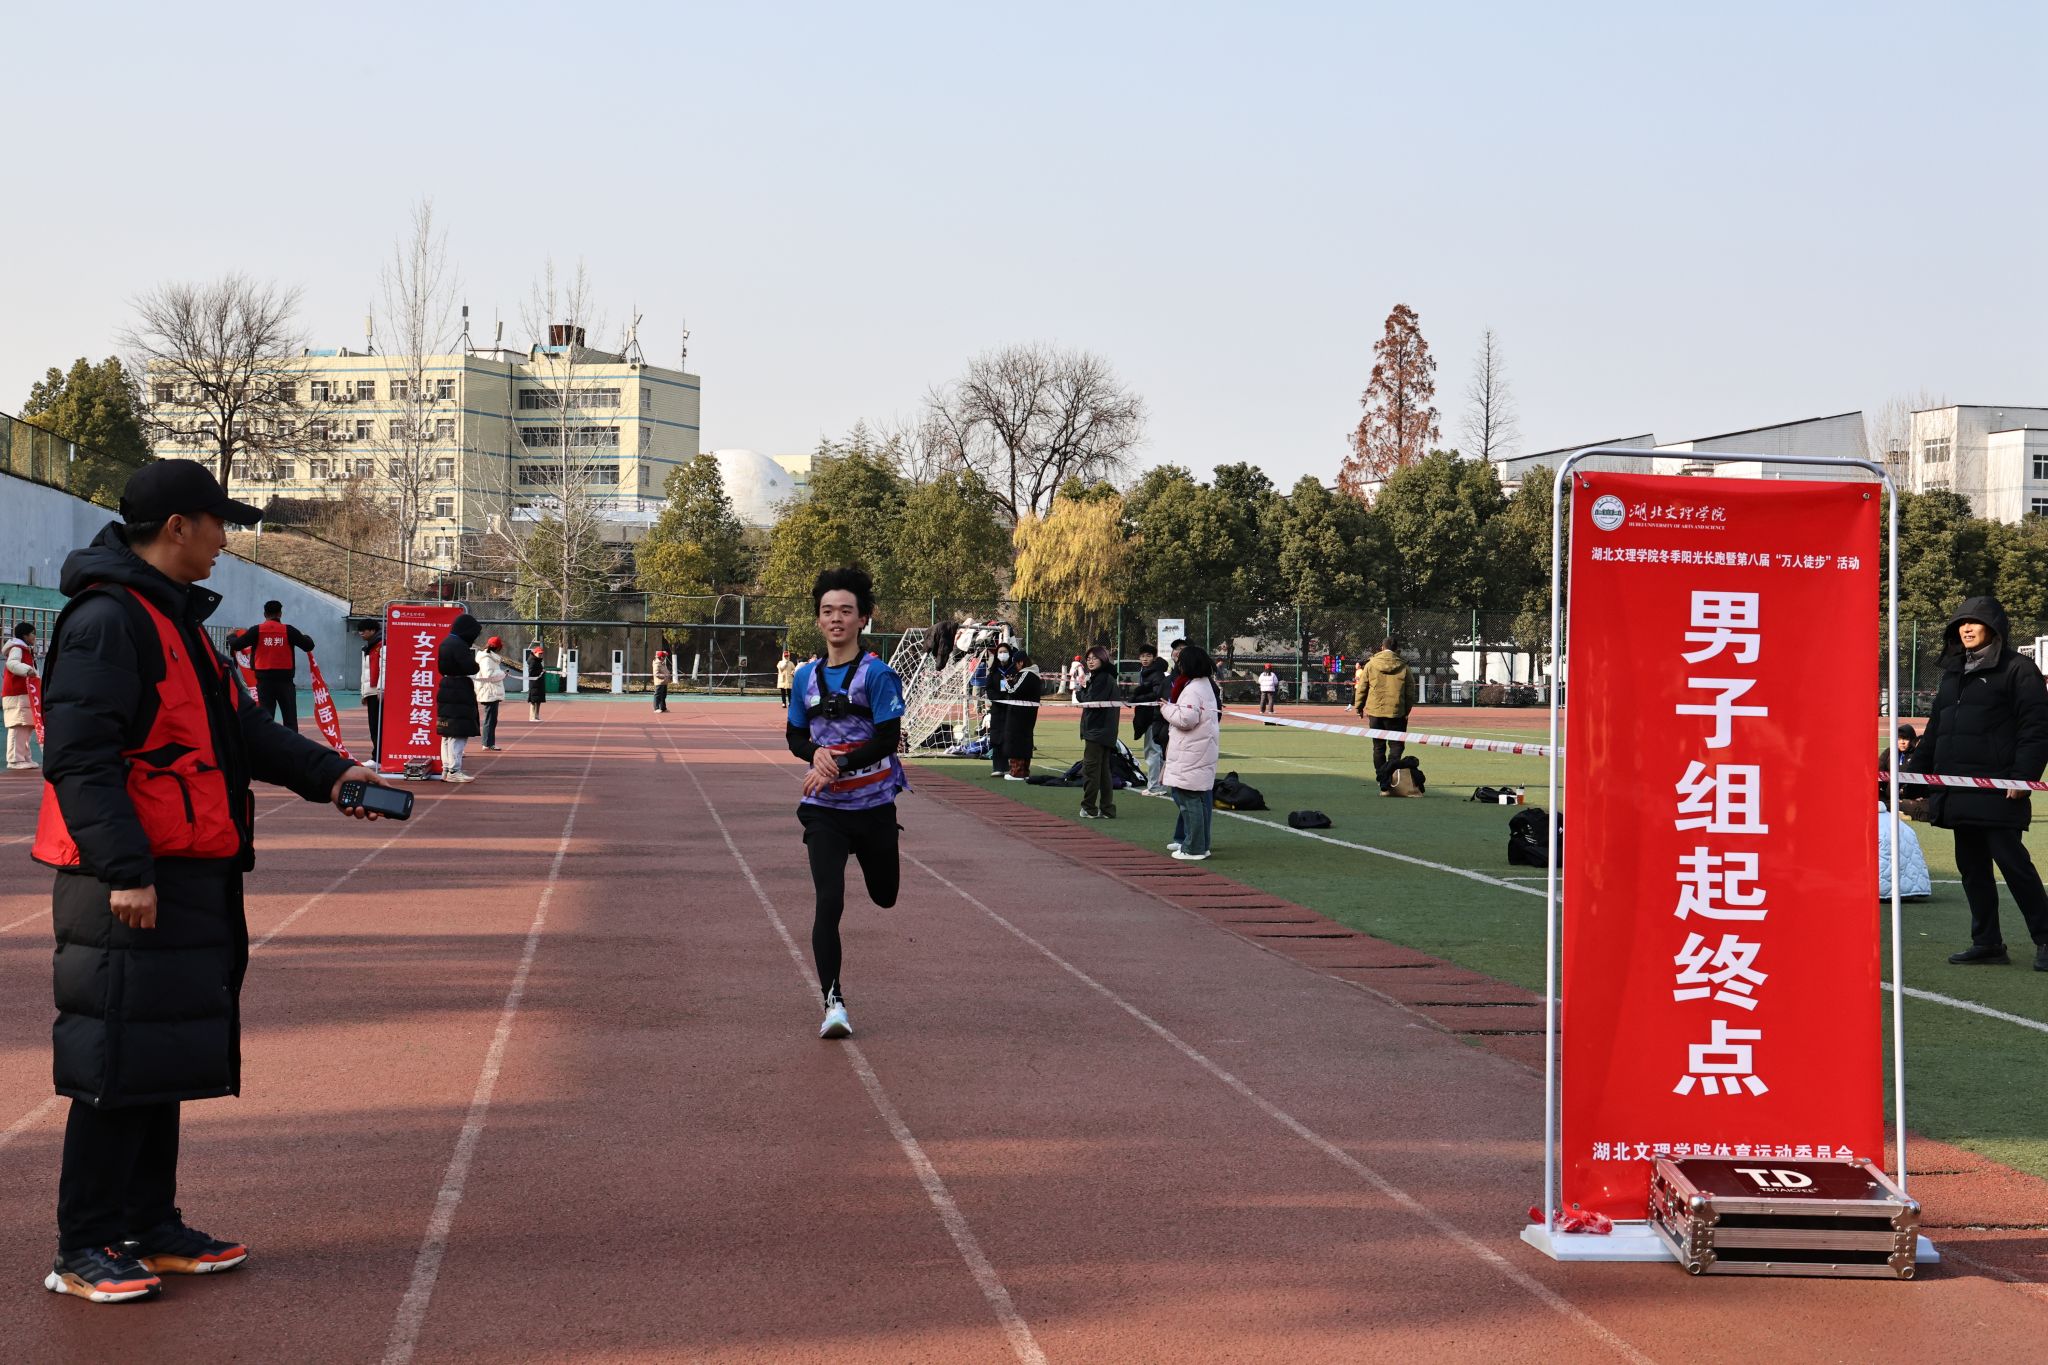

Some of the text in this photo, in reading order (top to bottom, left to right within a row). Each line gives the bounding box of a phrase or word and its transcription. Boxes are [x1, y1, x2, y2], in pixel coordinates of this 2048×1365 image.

[1628, 502, 1727, 522] 湖北文理学院
[263, 636, 285, 647] 裁判
[408, 630, 437, 746] 女子组起终点
[1672, 590, 1770, 1098] 男子组起终点
